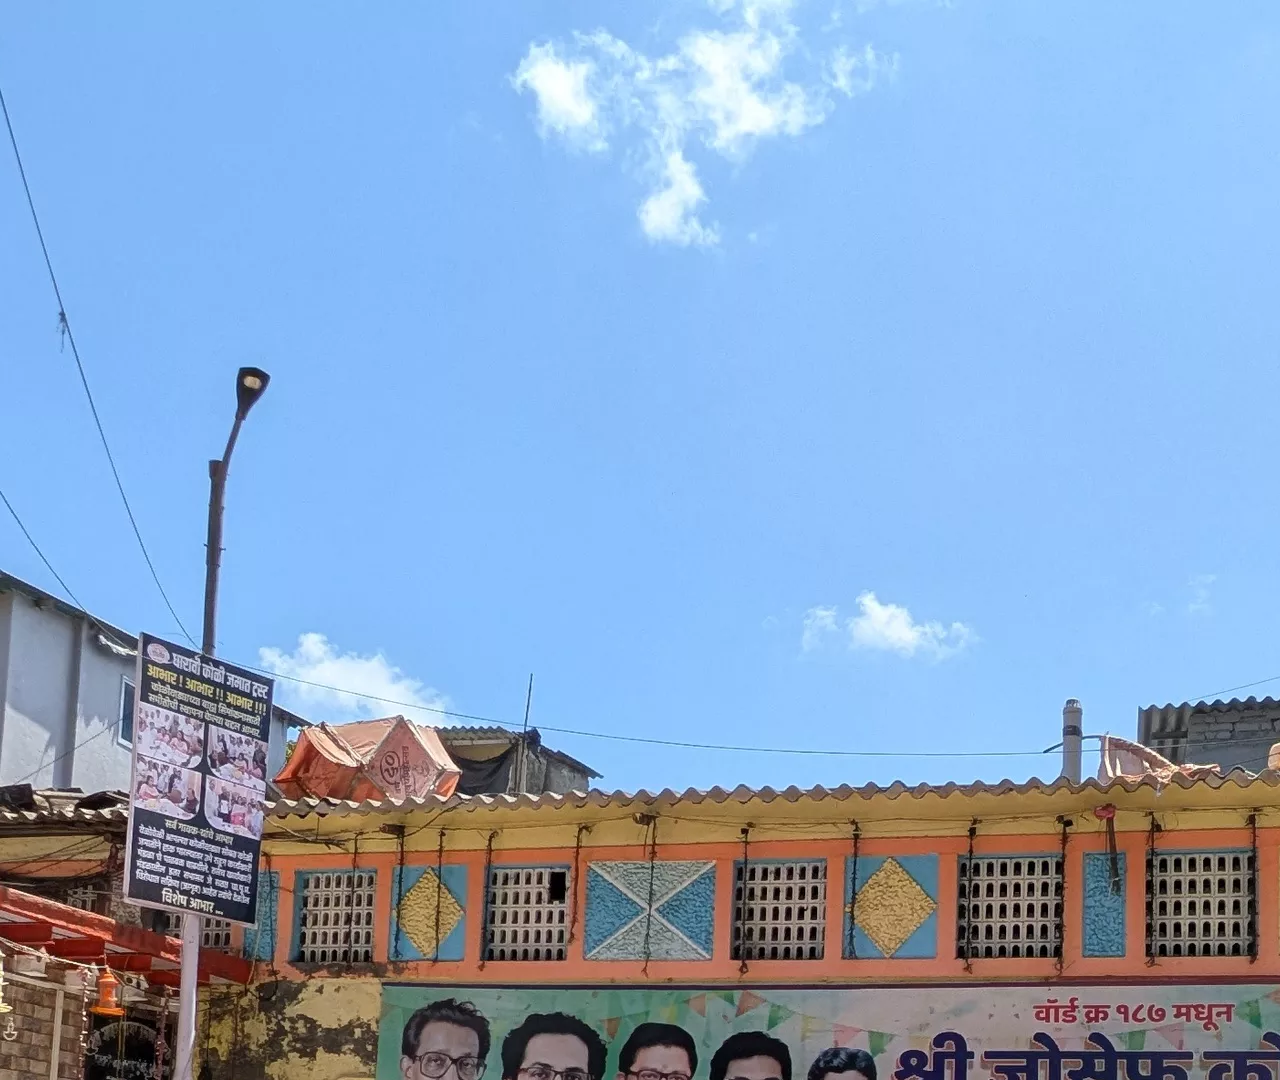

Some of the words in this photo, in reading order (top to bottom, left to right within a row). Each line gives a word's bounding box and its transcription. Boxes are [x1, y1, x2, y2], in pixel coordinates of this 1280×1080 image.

[147, 664, 177, 684] आभार
[185, 677, 214, 697] आभार
[226, 691, 253, 711] आभार
[202, 662, 225, 683] कोळी
[226, 672, 250, 692] जमात
[251, 681, 269, 698] ट्रस्ट
[179, 703, 203, 718] स्थापना
[161, 887, 187, 906] विशेष
[189, 897, 214, 912] आभार
[1032, 997, 1079, 1024] वॉर्ड
[1082, 1004, 1111, 1025] क्र
[1115, 1003, 1167, 1024] १८७
[1171, 1003, 1236, 1032] मधून
